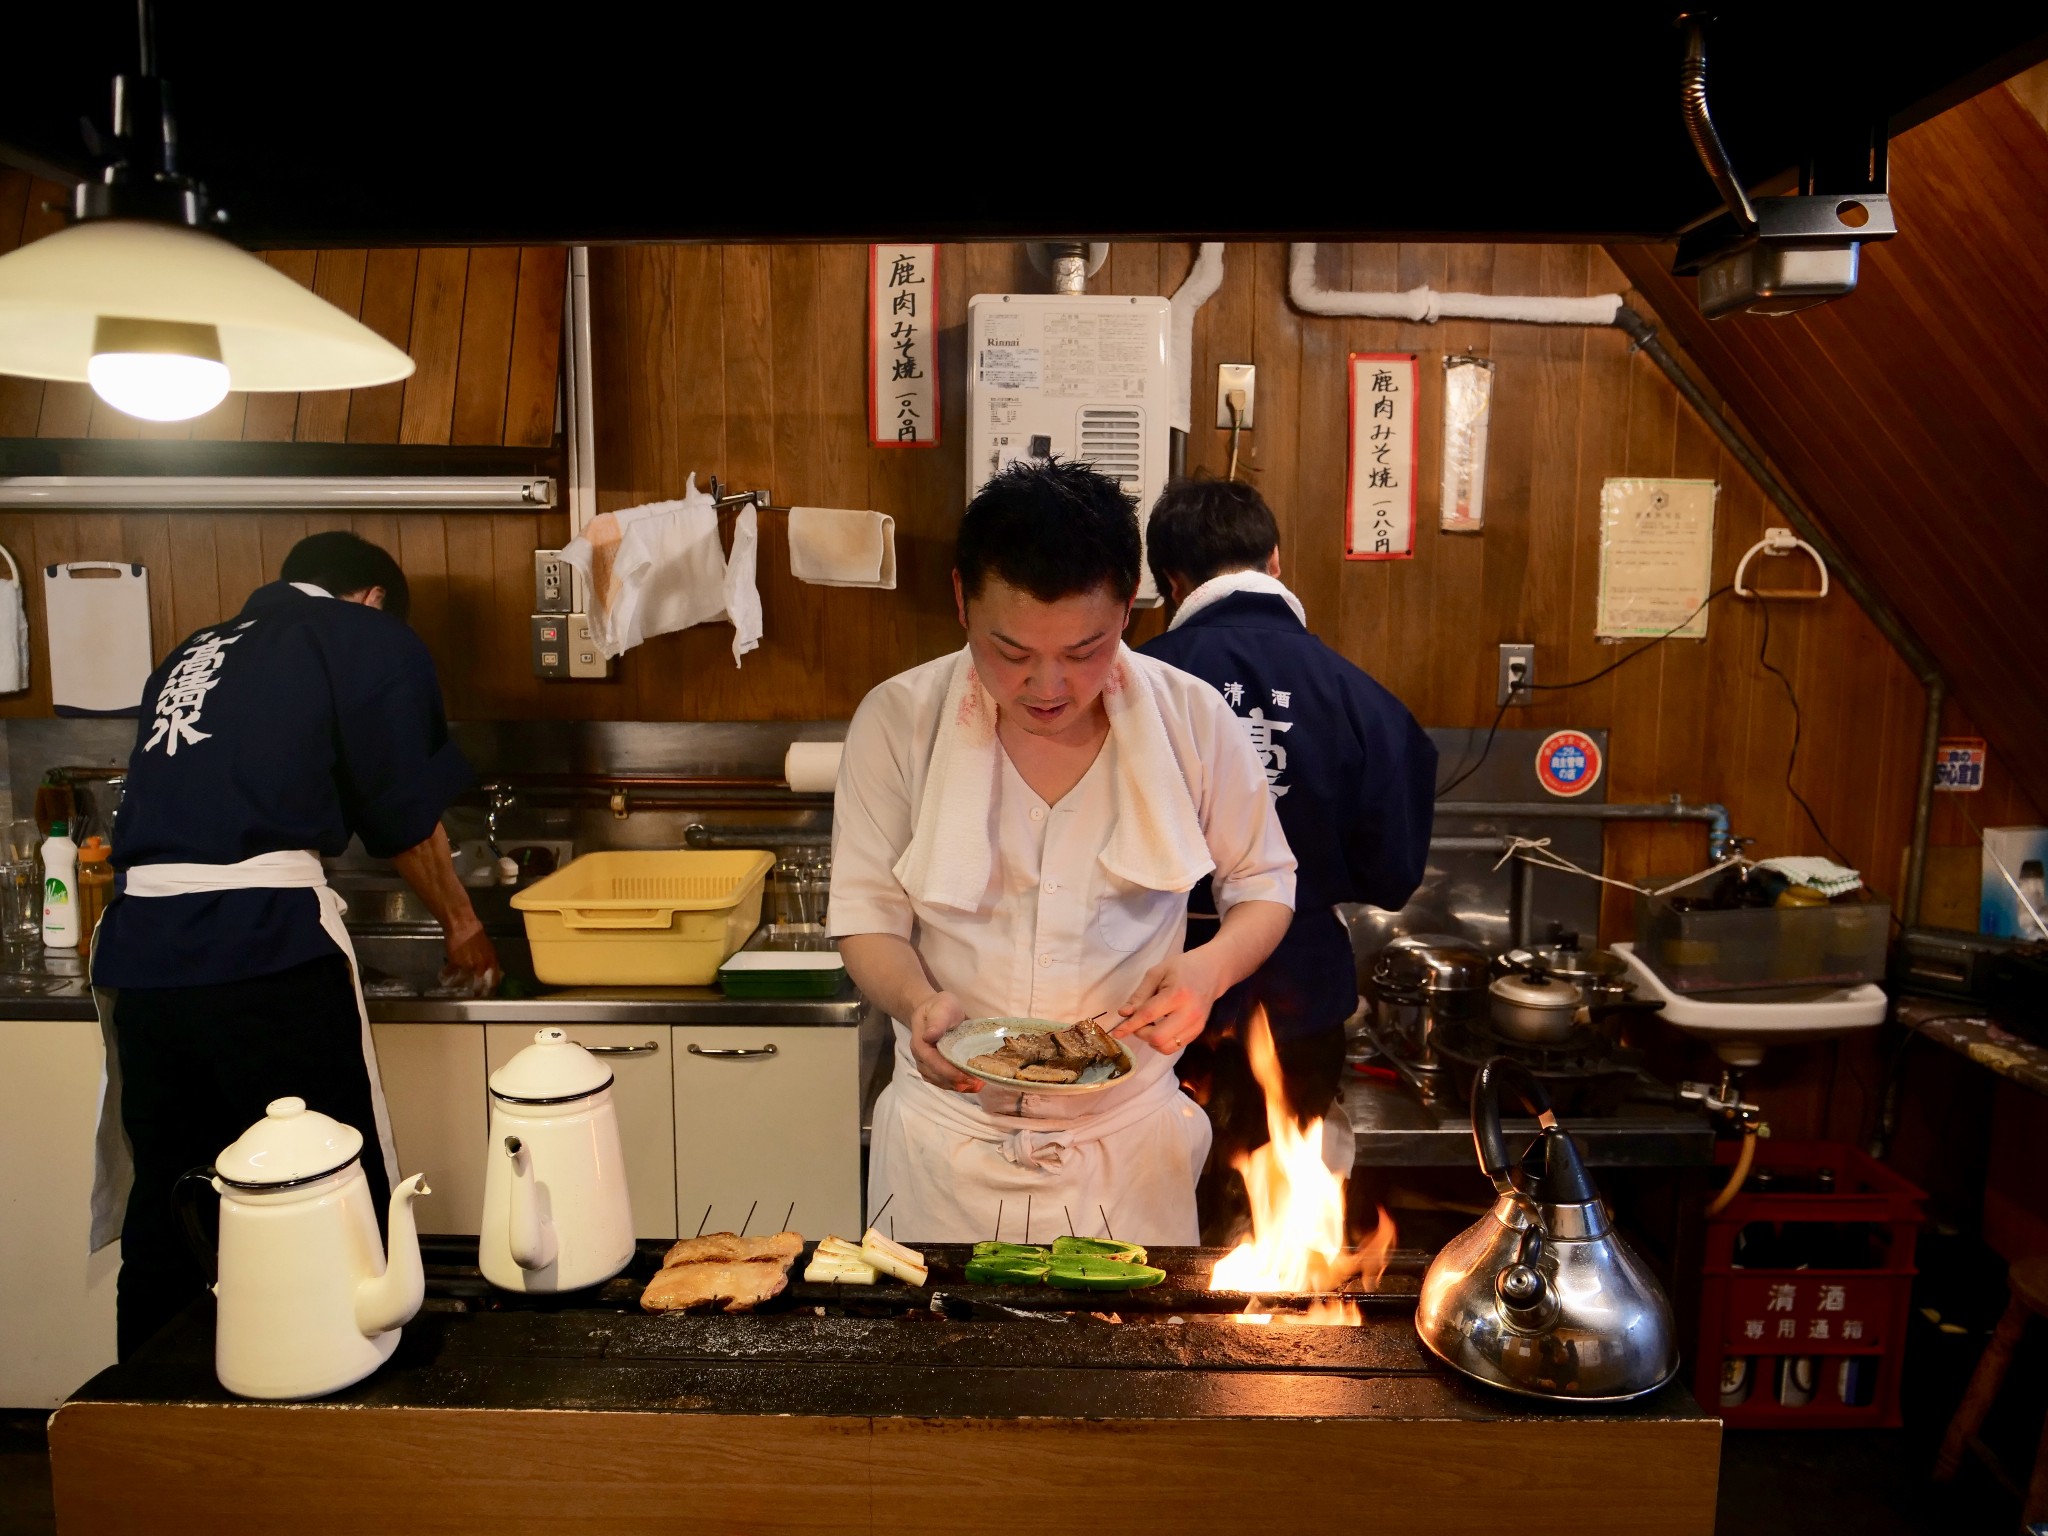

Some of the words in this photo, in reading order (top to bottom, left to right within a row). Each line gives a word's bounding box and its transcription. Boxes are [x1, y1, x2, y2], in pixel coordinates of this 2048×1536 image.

[986, 338, 1020, 347] Rinnai
[1223, 681, 1291, 709] 清酒
[1767, 1283, 1846, 1311] 清酒
